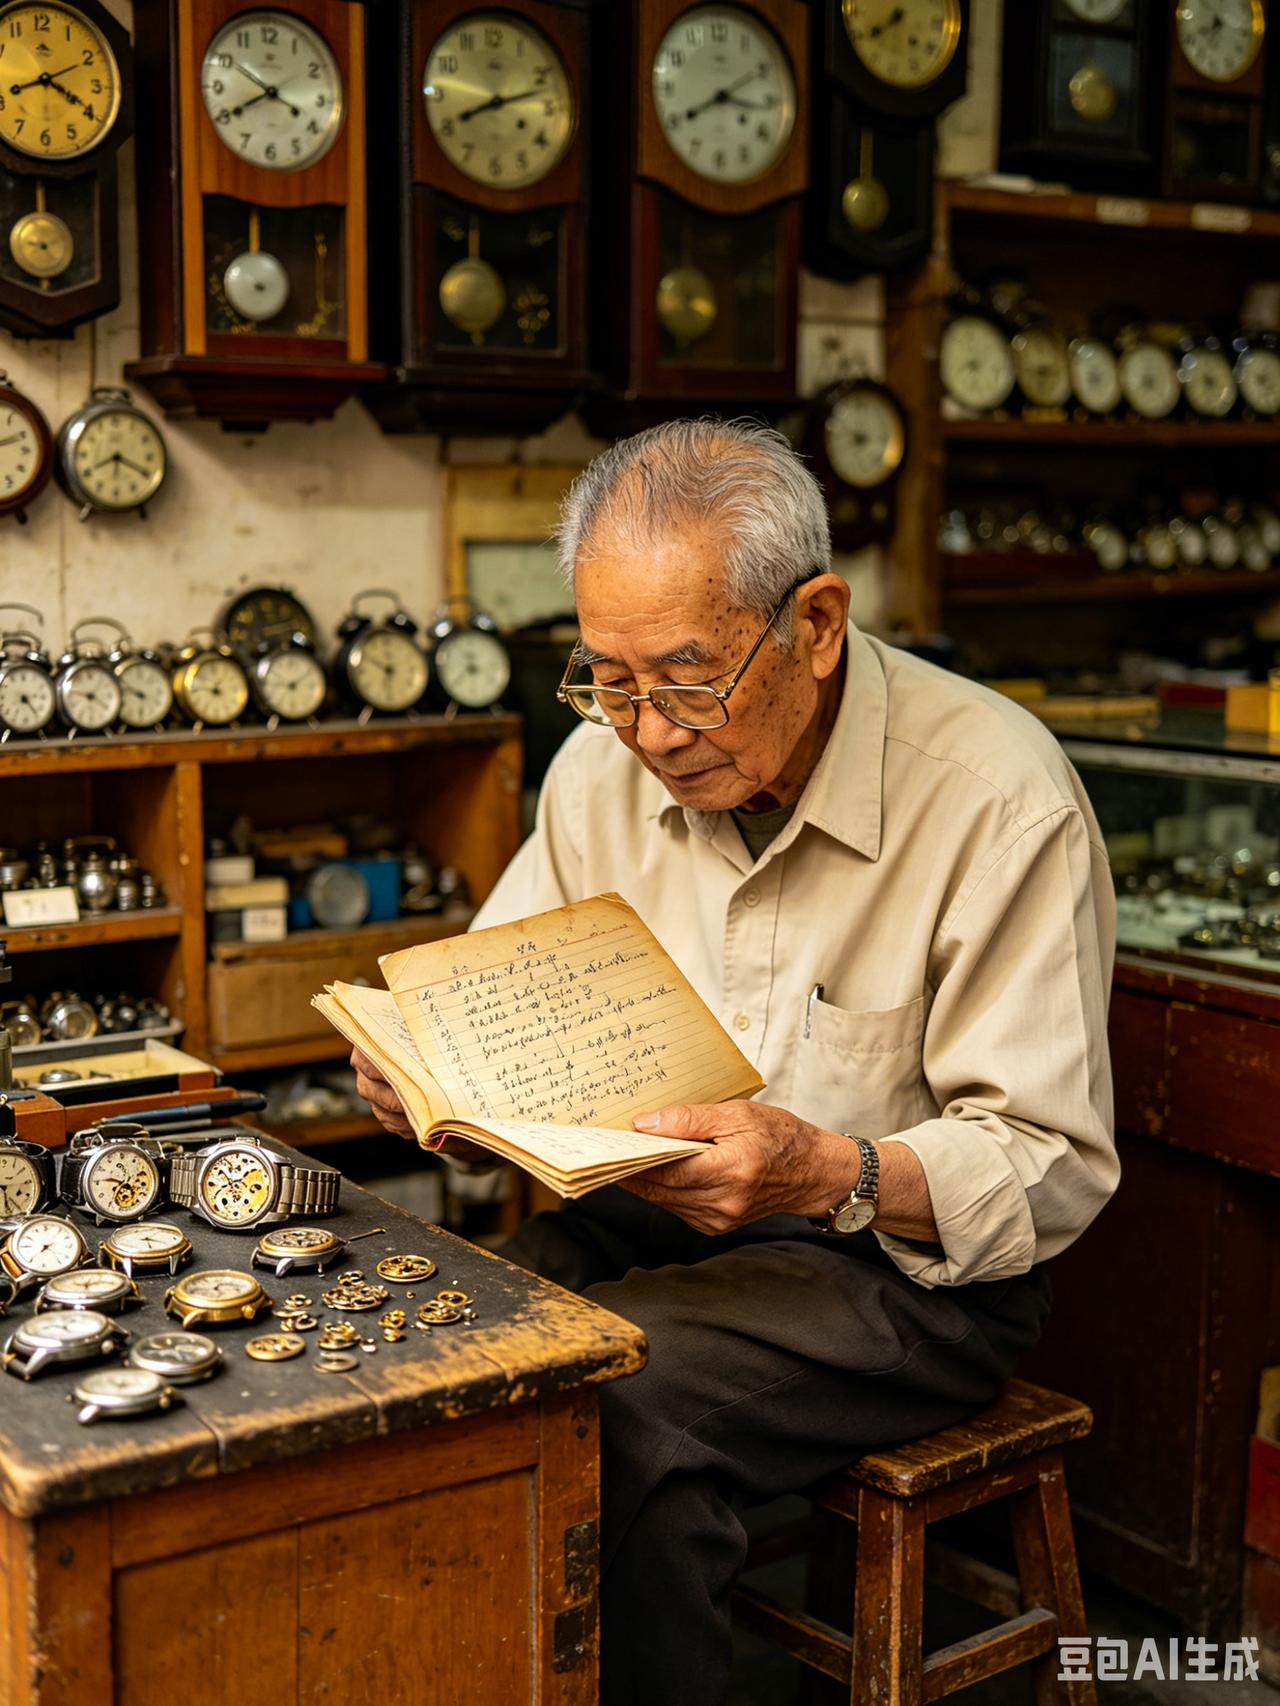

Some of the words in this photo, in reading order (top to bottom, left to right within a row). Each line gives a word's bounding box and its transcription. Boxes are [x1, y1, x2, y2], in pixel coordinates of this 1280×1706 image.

[10, 22, 22, 38] 11
[34, 14, 51, 32] 12
[66, 25, 71, 42] 1
[237, 31, 249, 49] 11
[261, 26, 279, 45] 12
[292, 37, 298, 55] 1
[82, 50, 94, 66] 2
[308, 62, 319, 79] 2
[91, 79, 102, 94] 3
[315, 94, 325, 108] 3
[83, 104, 94, 121] 4
[15, 119, 25, 134] 7
[66, 124, 77, 140] 5
[40, 129, 50, 147] 6
[240, 133, 252, 149] 7
[291, 138, 301, 155] 5
[265, 143, 277, 161] 6
